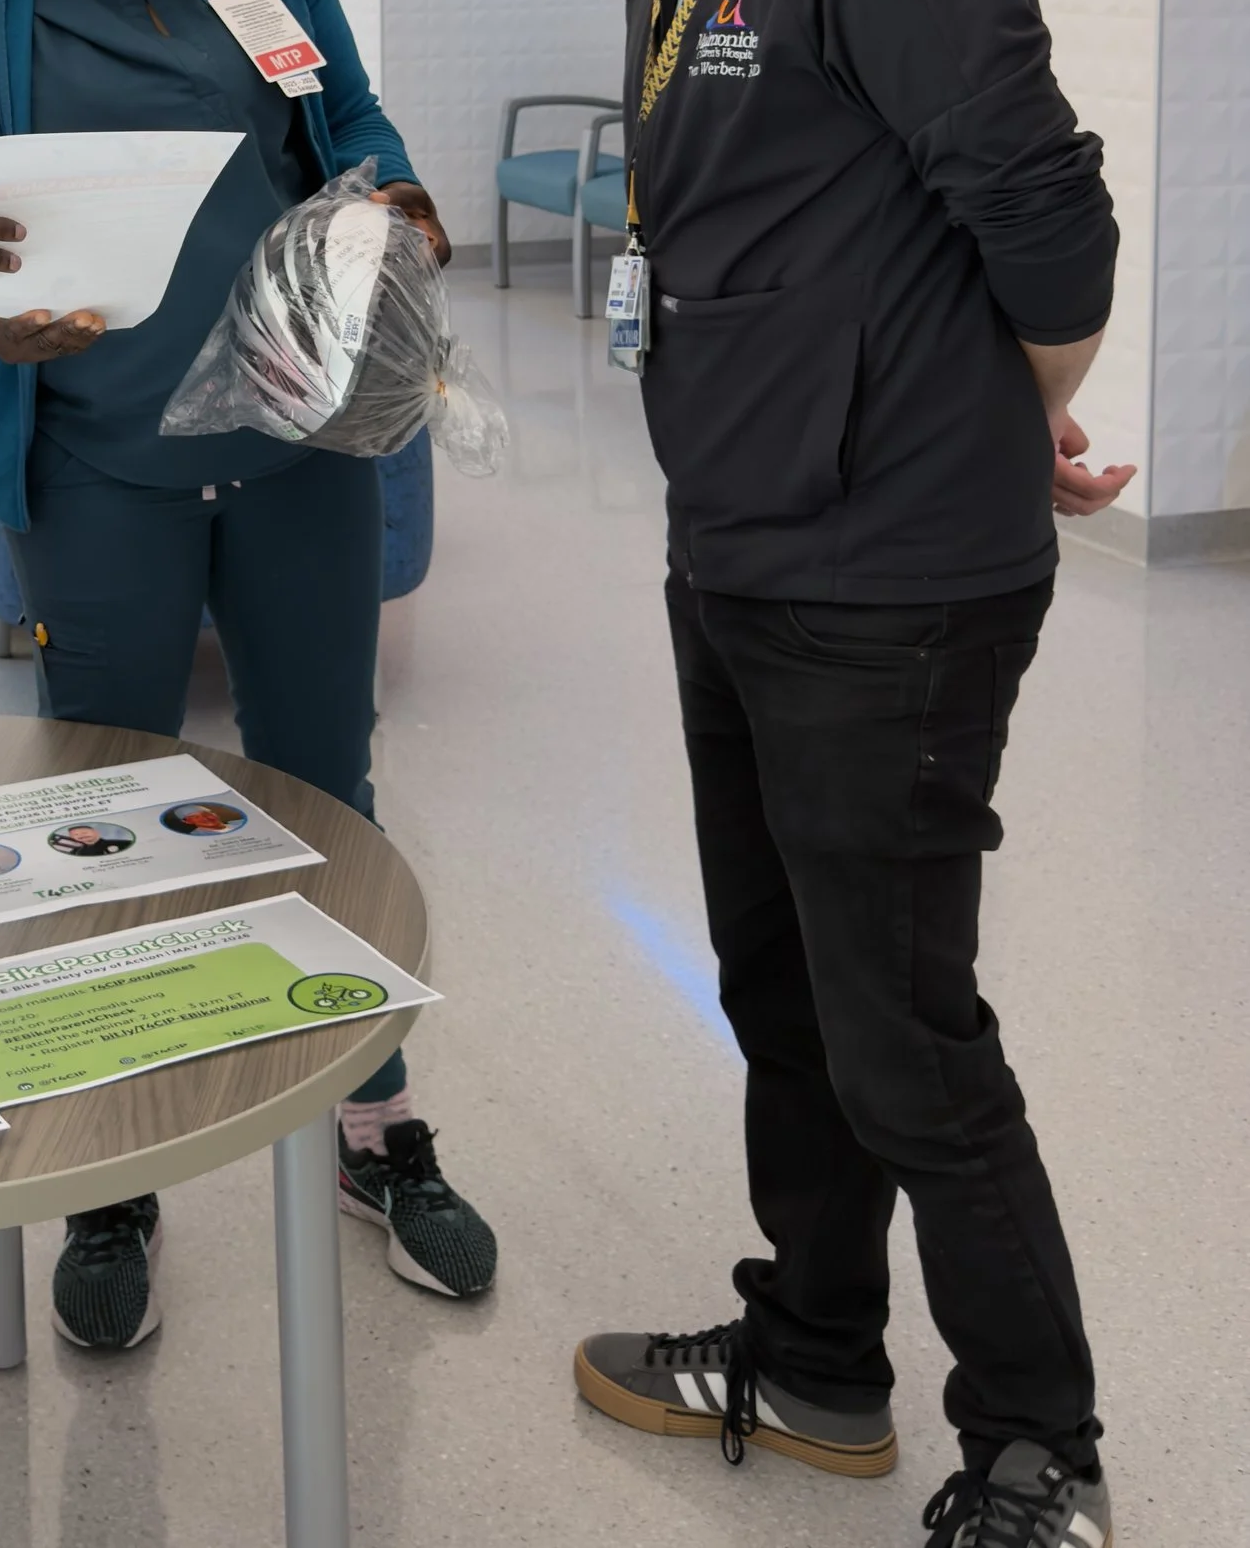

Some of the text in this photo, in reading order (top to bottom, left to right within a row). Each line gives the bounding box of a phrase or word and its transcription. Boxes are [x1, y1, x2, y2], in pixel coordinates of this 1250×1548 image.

[696, 31, 759, 50] Maimonide
[270, 49, 302, 70] MTP
[700, 61, 746, 78] Werber,
[282, 80, 297, 89] 2025
[612, 329, 639, 345] OCTOR
[38, 792, 73, 802] Risk
[94, 780, 142, 792] Youth
[53, 772, 137, 793] E-Bikes
[21, 803, 54, 812] Child
[52, 797, 89, 807] Injury
[87, 786, 151, 800] Prevention
[10, 812, 42, 820] 2026
[32, 880, 99, 900] T4CIP
[40, 971, 84, 985] Safety
[81, 965, 110, 975] Day
[106, 961, 123, 969] of
[121, 952, 166, 966] Action
[169, 944, 201, 954] MAY
[219, 932, 252, 943] 2026
[87, 962, 198, 992] T4CIP.org/ebikes
[25, 1020, 47, 1028] on
[44, 1010, 85, 1024] social
[84, 999, 129, 1014] media
[127, 991, 167, 1004] using
[96, 993, 274, 1042] bit.ly/T4CIP-EBikeWebinar
[0, 1007, 138, 1044] #EBikeParentCheck
[8, 1037, 55, 1052] Watch
[54, 1031, 81, 1041] the
[224, 991, 246, 1000] ET
[35, 1068, 90, 1086] @T4CIP
[137, 1041, 192, 1059] @T4CIP
[222, 1022, 268, 1038] T4CIP
